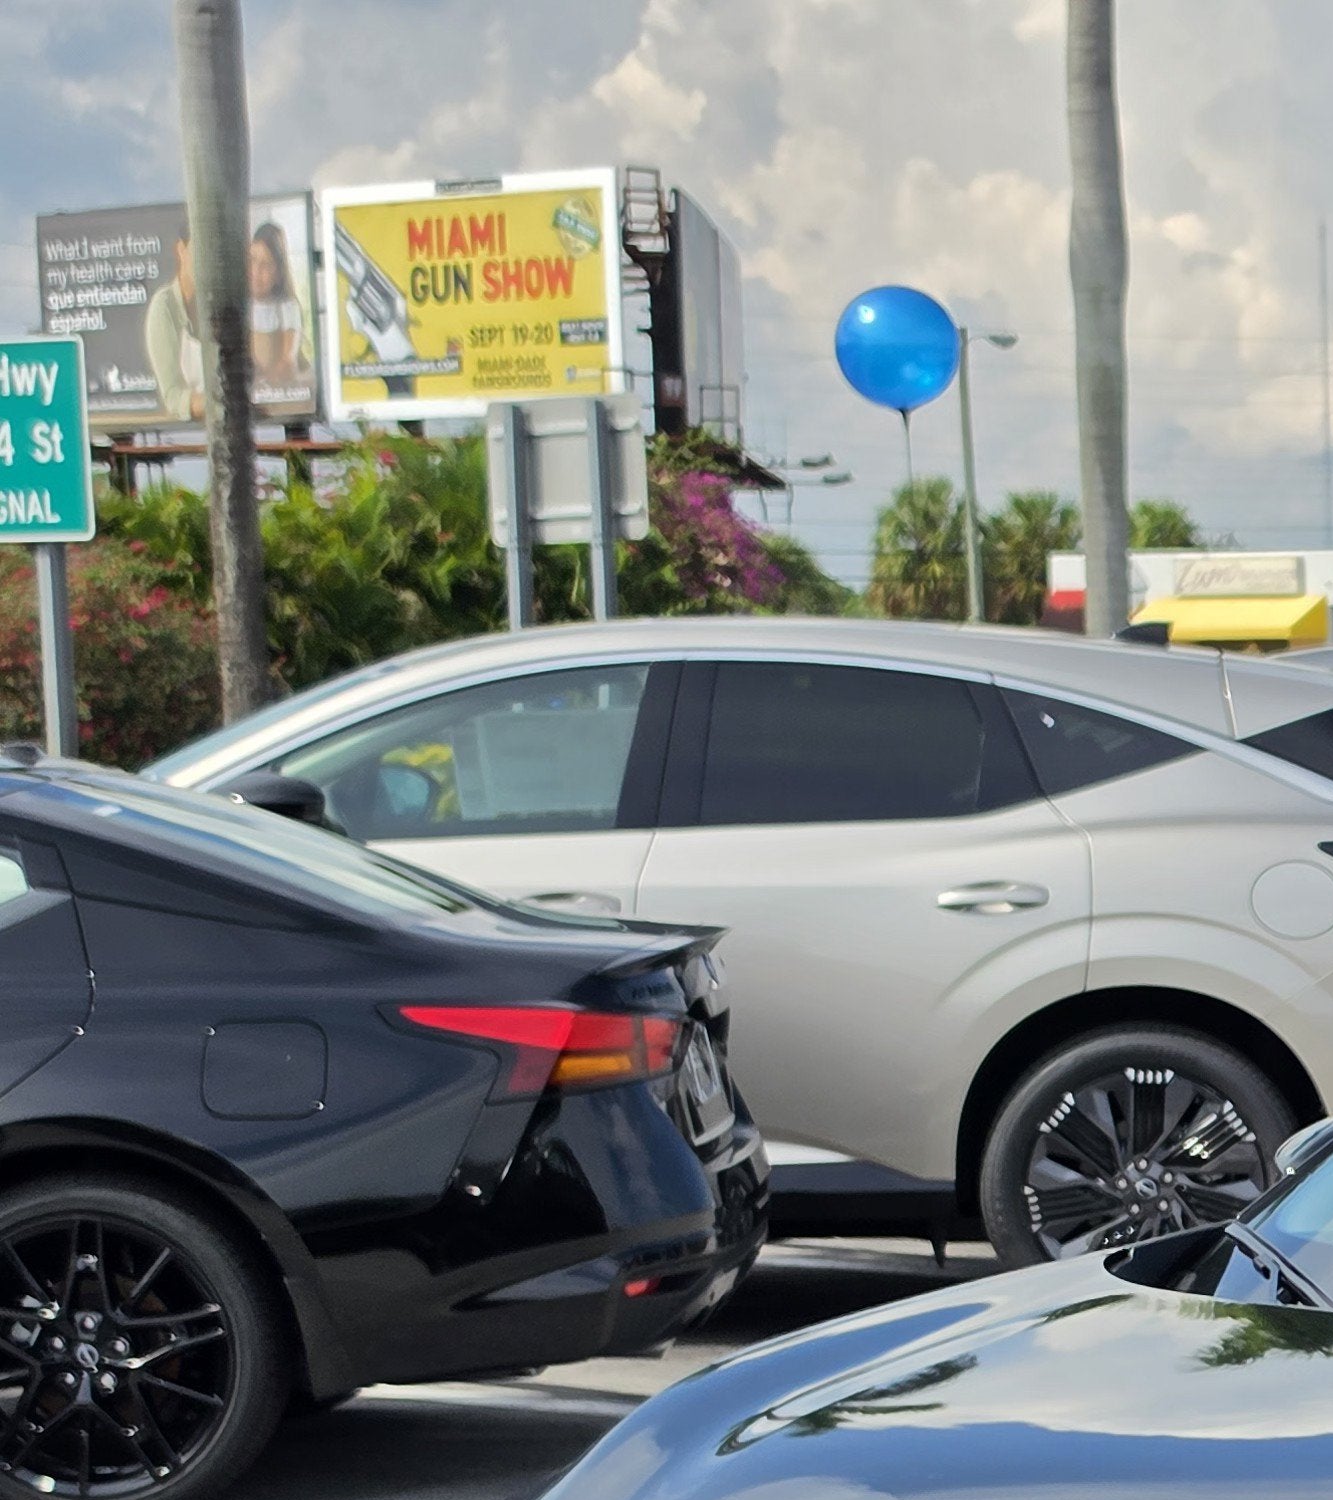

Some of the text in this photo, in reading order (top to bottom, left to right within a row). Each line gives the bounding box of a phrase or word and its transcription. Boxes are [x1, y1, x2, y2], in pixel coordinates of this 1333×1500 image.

[44, 239, 80, 261] What
[91, 237, 124, 257] want
[126, 232, 161, 255] from
[407, 212, 507, 261] MIAMI
[46, 258, 159, 290] my health care is
[410, 254, 575, 303] GUN SHOW
[46, 283, 147, 312] que entiendan
[469, 324, 505, 348] SEPT
[32, 420, 64, 464] St
